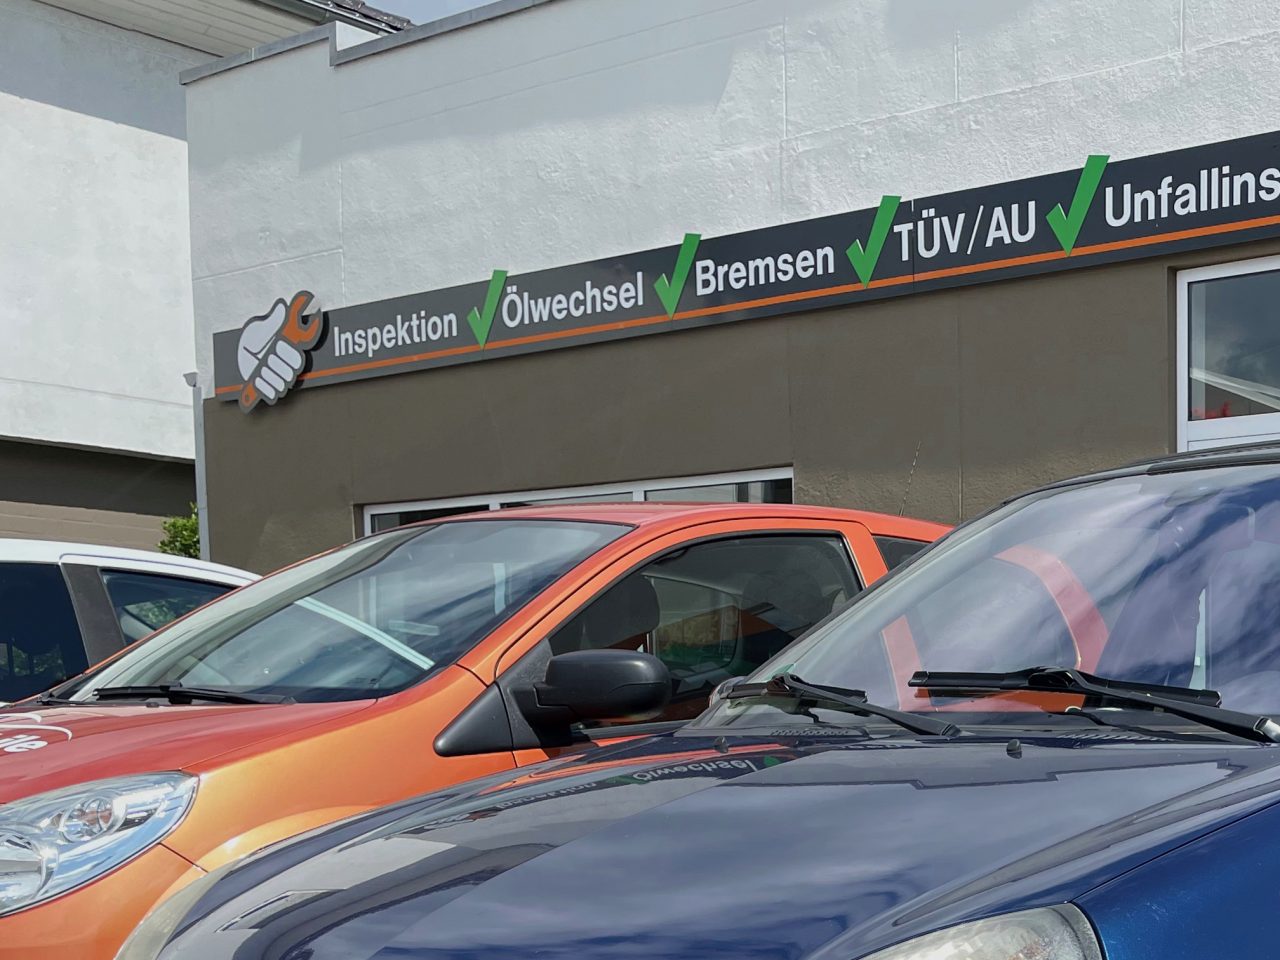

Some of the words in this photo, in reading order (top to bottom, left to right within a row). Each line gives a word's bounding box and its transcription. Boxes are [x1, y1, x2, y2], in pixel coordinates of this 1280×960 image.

[333, 311, 458, 358] Inspektion
[502, 271, 644, 328] Ölwechsel
[695, 246, 836, 296] Bremsen
